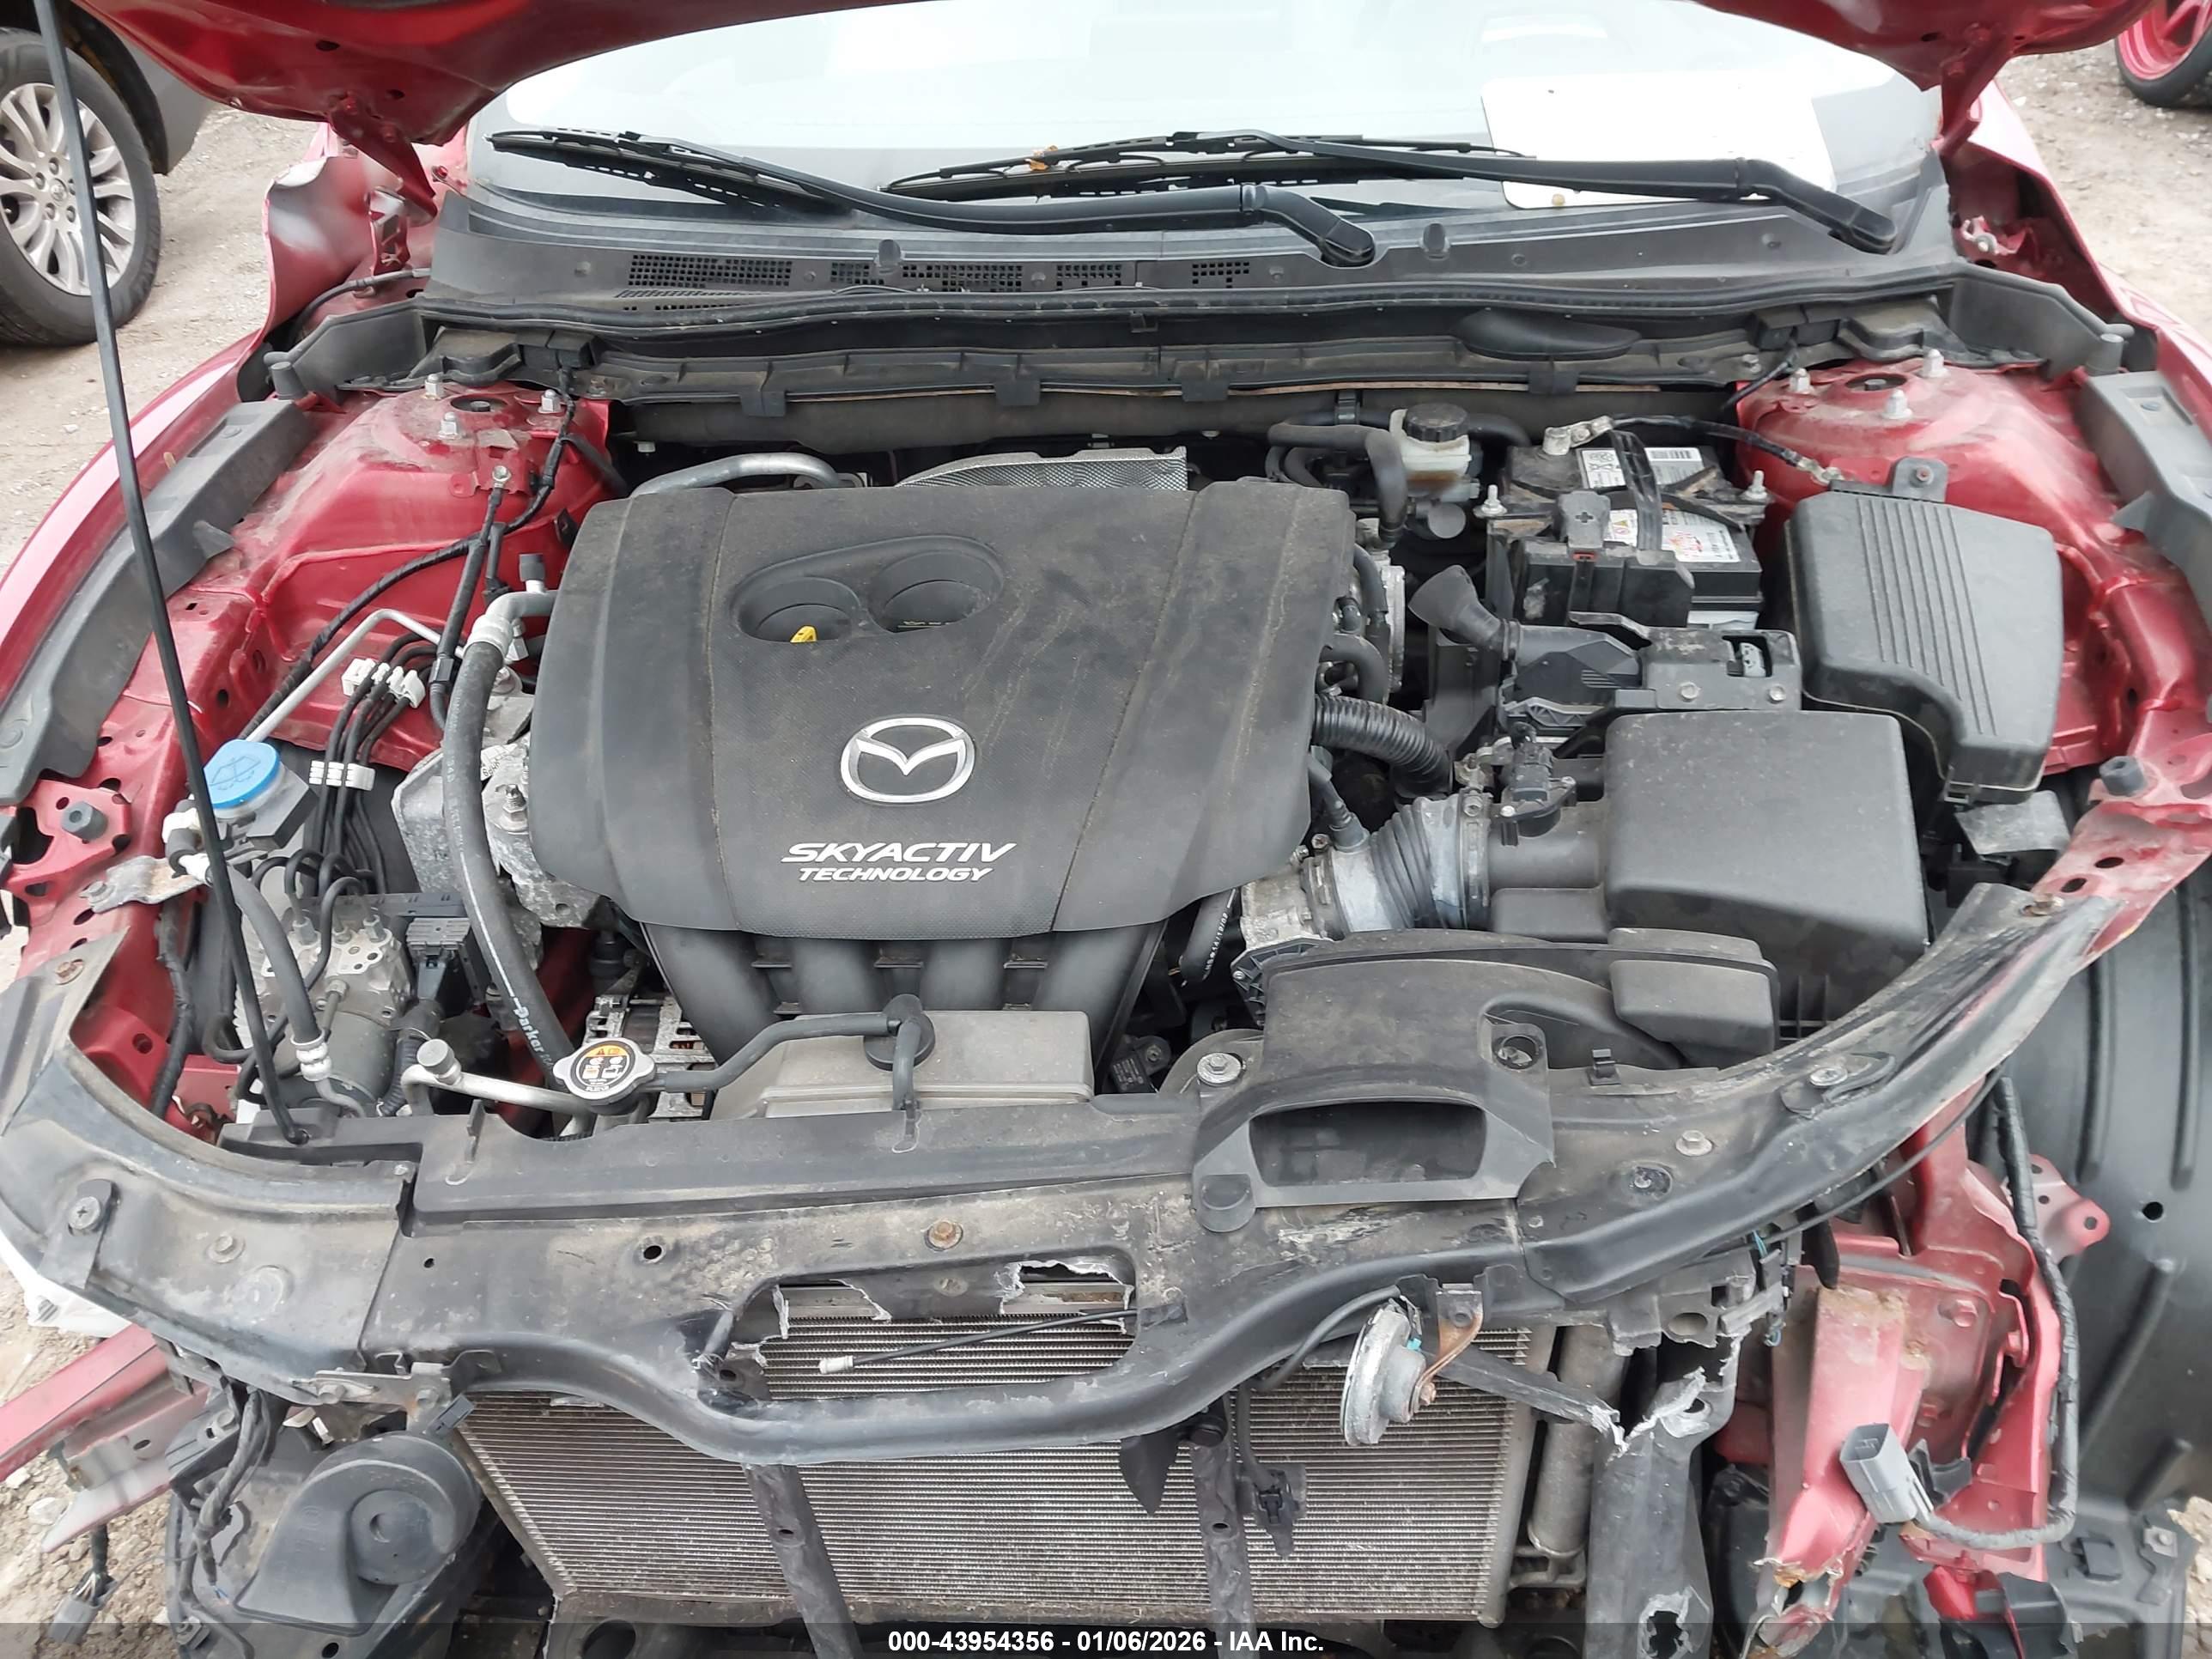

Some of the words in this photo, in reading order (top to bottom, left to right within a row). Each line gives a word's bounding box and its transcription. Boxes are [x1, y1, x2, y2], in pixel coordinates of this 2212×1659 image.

[781, 842, 1018, 863] SKYACTIV
[799, 866, 993, 882] TECHNOLOGY
[513, 1005, 545, 1053] Parker
